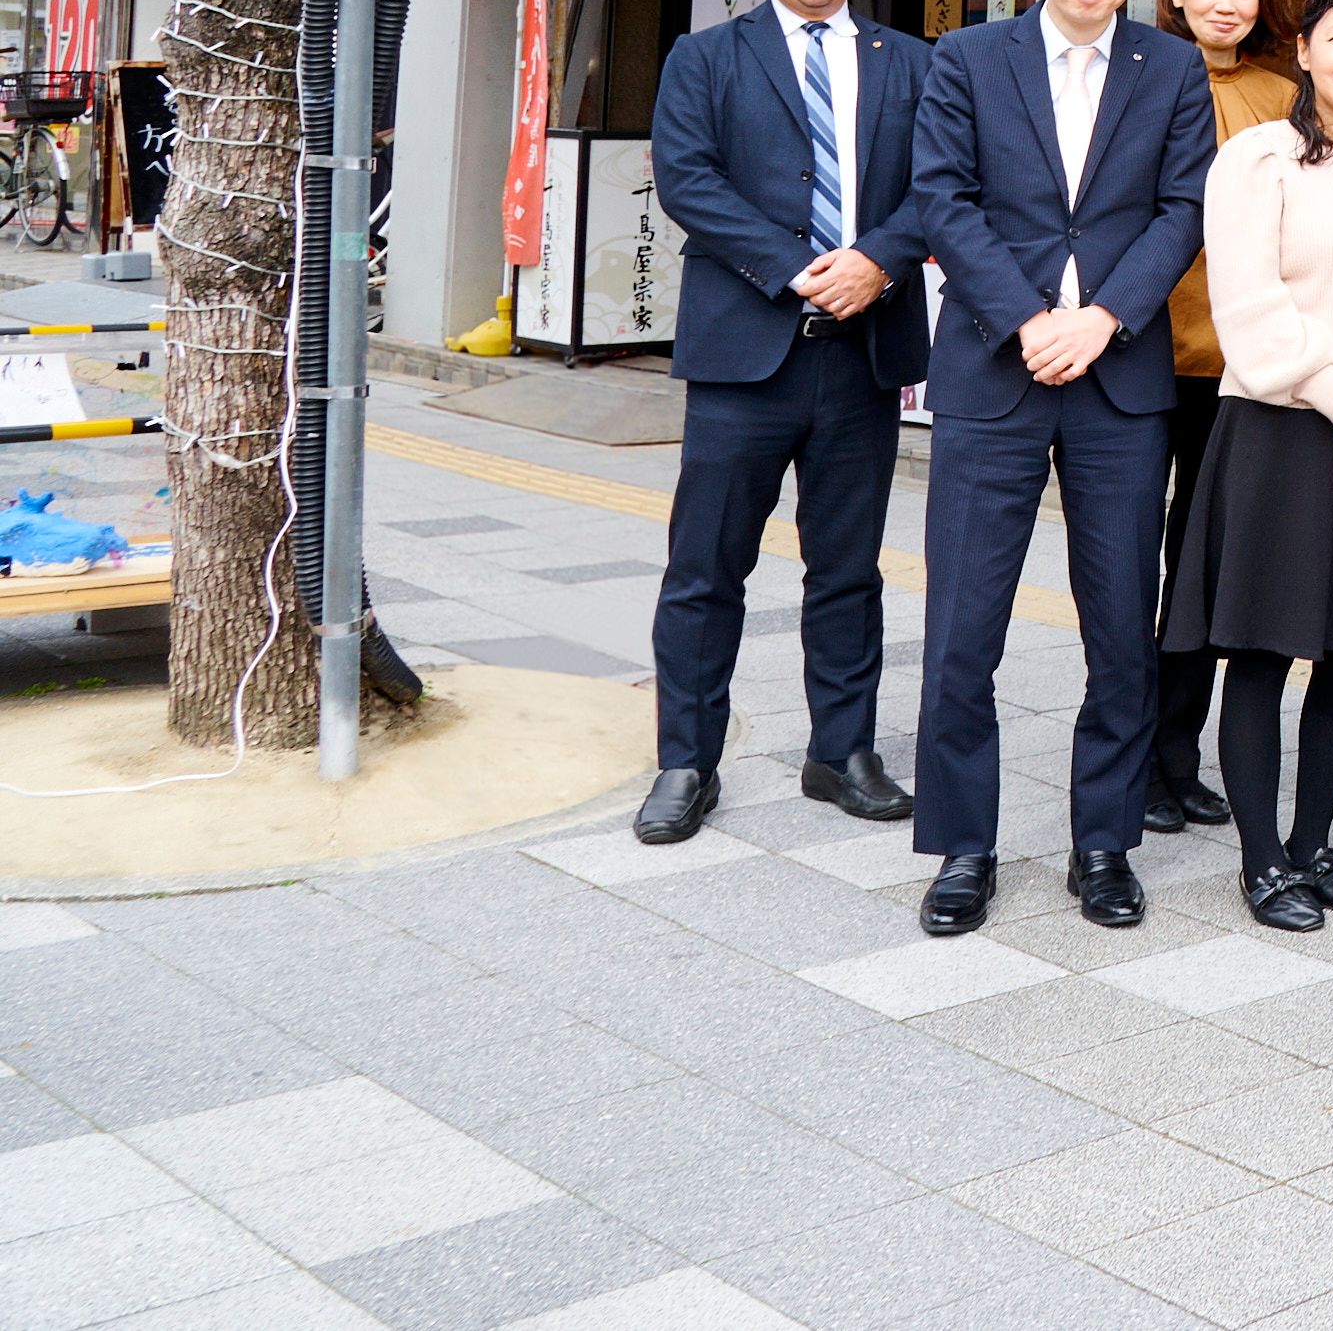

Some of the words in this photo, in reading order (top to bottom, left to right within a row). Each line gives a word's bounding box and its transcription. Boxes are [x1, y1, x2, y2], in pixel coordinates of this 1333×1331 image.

[631, 180, 655, 332] 千鳥屋宗家
